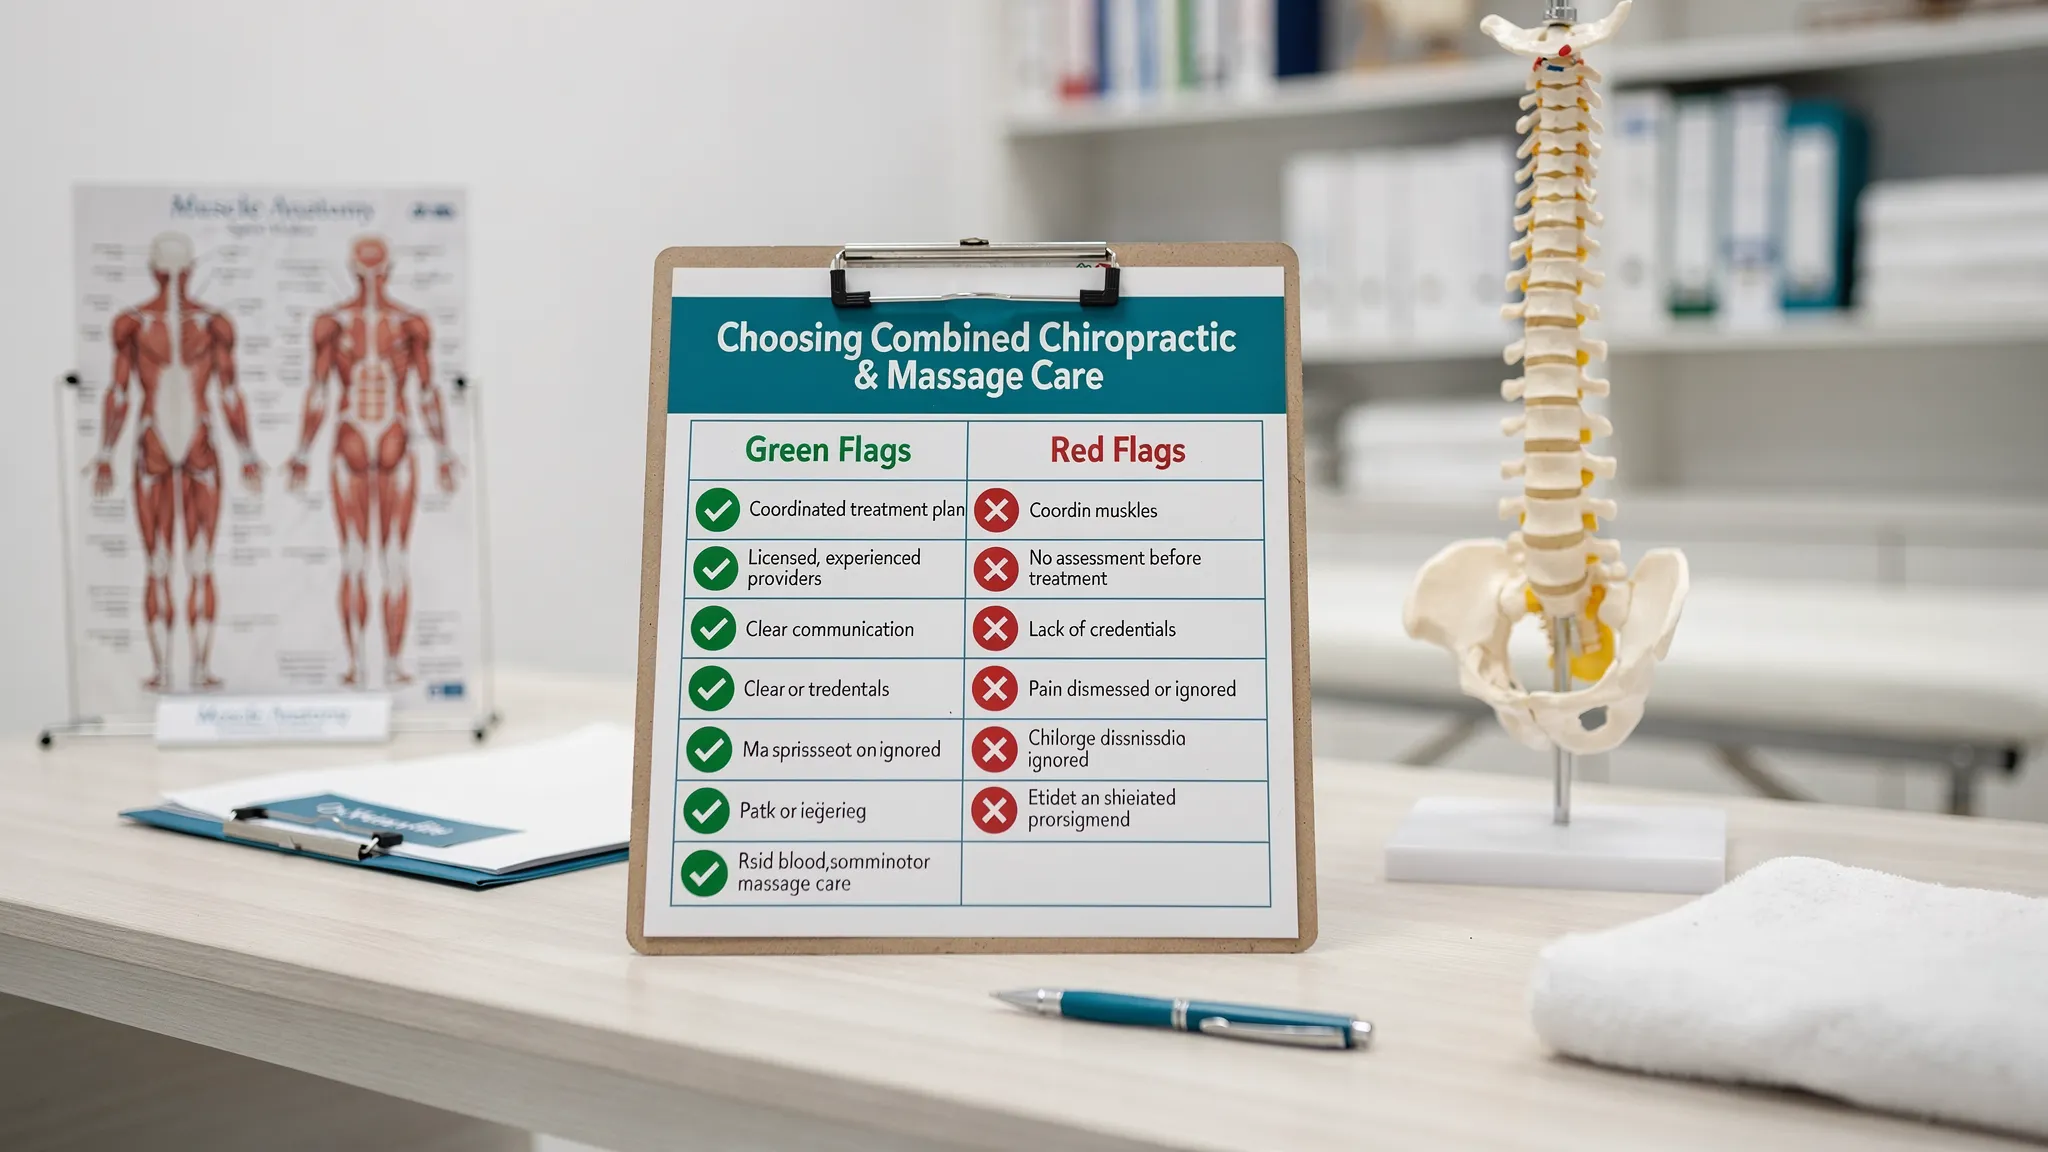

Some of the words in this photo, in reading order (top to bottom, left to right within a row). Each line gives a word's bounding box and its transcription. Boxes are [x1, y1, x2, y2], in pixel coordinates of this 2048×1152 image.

[717, 320, 863, 361] Choosing
[870, 320, 1030, 353] Combined
[1038, 320, 1237, 361] Chiropractic
[854, 361, 879, 391] &
[887, 360, 1024, 399] Massage
[1030, 359, 1104, 391] Care
[745, 434, 829, 463] Green
[839, 434, 912, 471] Flags
[1051, 434, 1104, 463] Red
[1113, 434, 1186, 471] Flags
[749, 498, 847, 518] Coordinated
[849, 501, 929, 518] treatment
[931, 499, 966, 522] plan
[1029, 501, 1091, 519] Coordin
[1095, 500, 1158, 519] muskles
[748, 547, 821, 569] Licensed,
[825, 547, 921, 571] experienced
[1029, 548, 1053, 566] No
[1055, 551, 1146, 566] assessment
[1149, 547, 1202, 566] before
[747, 567, 822, 591] providers
[1028, 570, 1108, 587] treatment
[745, 619, 789, 638] Clear
[792, 619, 915, 638] communication
[1029, 619, 1065, 638] Lack
[1068, 618, 1087, 638] of
[1089, 619, 1177, 638] credentials
[743, 678, 786, 698] Clear
[787, 685, 806, 698] or
[807, 678, 890, 698] tredentals
[1029, 679, 1062, 698] Pain
[1066, 678, 1150, 698] dismessed
[1154, 685, 1172, 698] or
[1175, 678, 1237, 703] ignored
[1028, 727, 1096, 751] Chilorge
[1100, 727, 1186, 747] dissnissdia
[743, 740, 769, 758] Ma
[772, 740, 853, 764] sprissseot
[1028, 749, 1089, 774] ignored
[1028, 787, 1078, 806] Etidet
[1080, 793, 1100, 806] an
[1104, 787, 1176, 806] shieiated
[740, 800, 777, 820] Patk
[779, 806, 798, 820] or
[1028, 810, 1130, 833] prorsigmend
[738, 851, 774, 870] Rsid
[737, 878, 811, 897] massage
[815, 878, 851, 892] care
